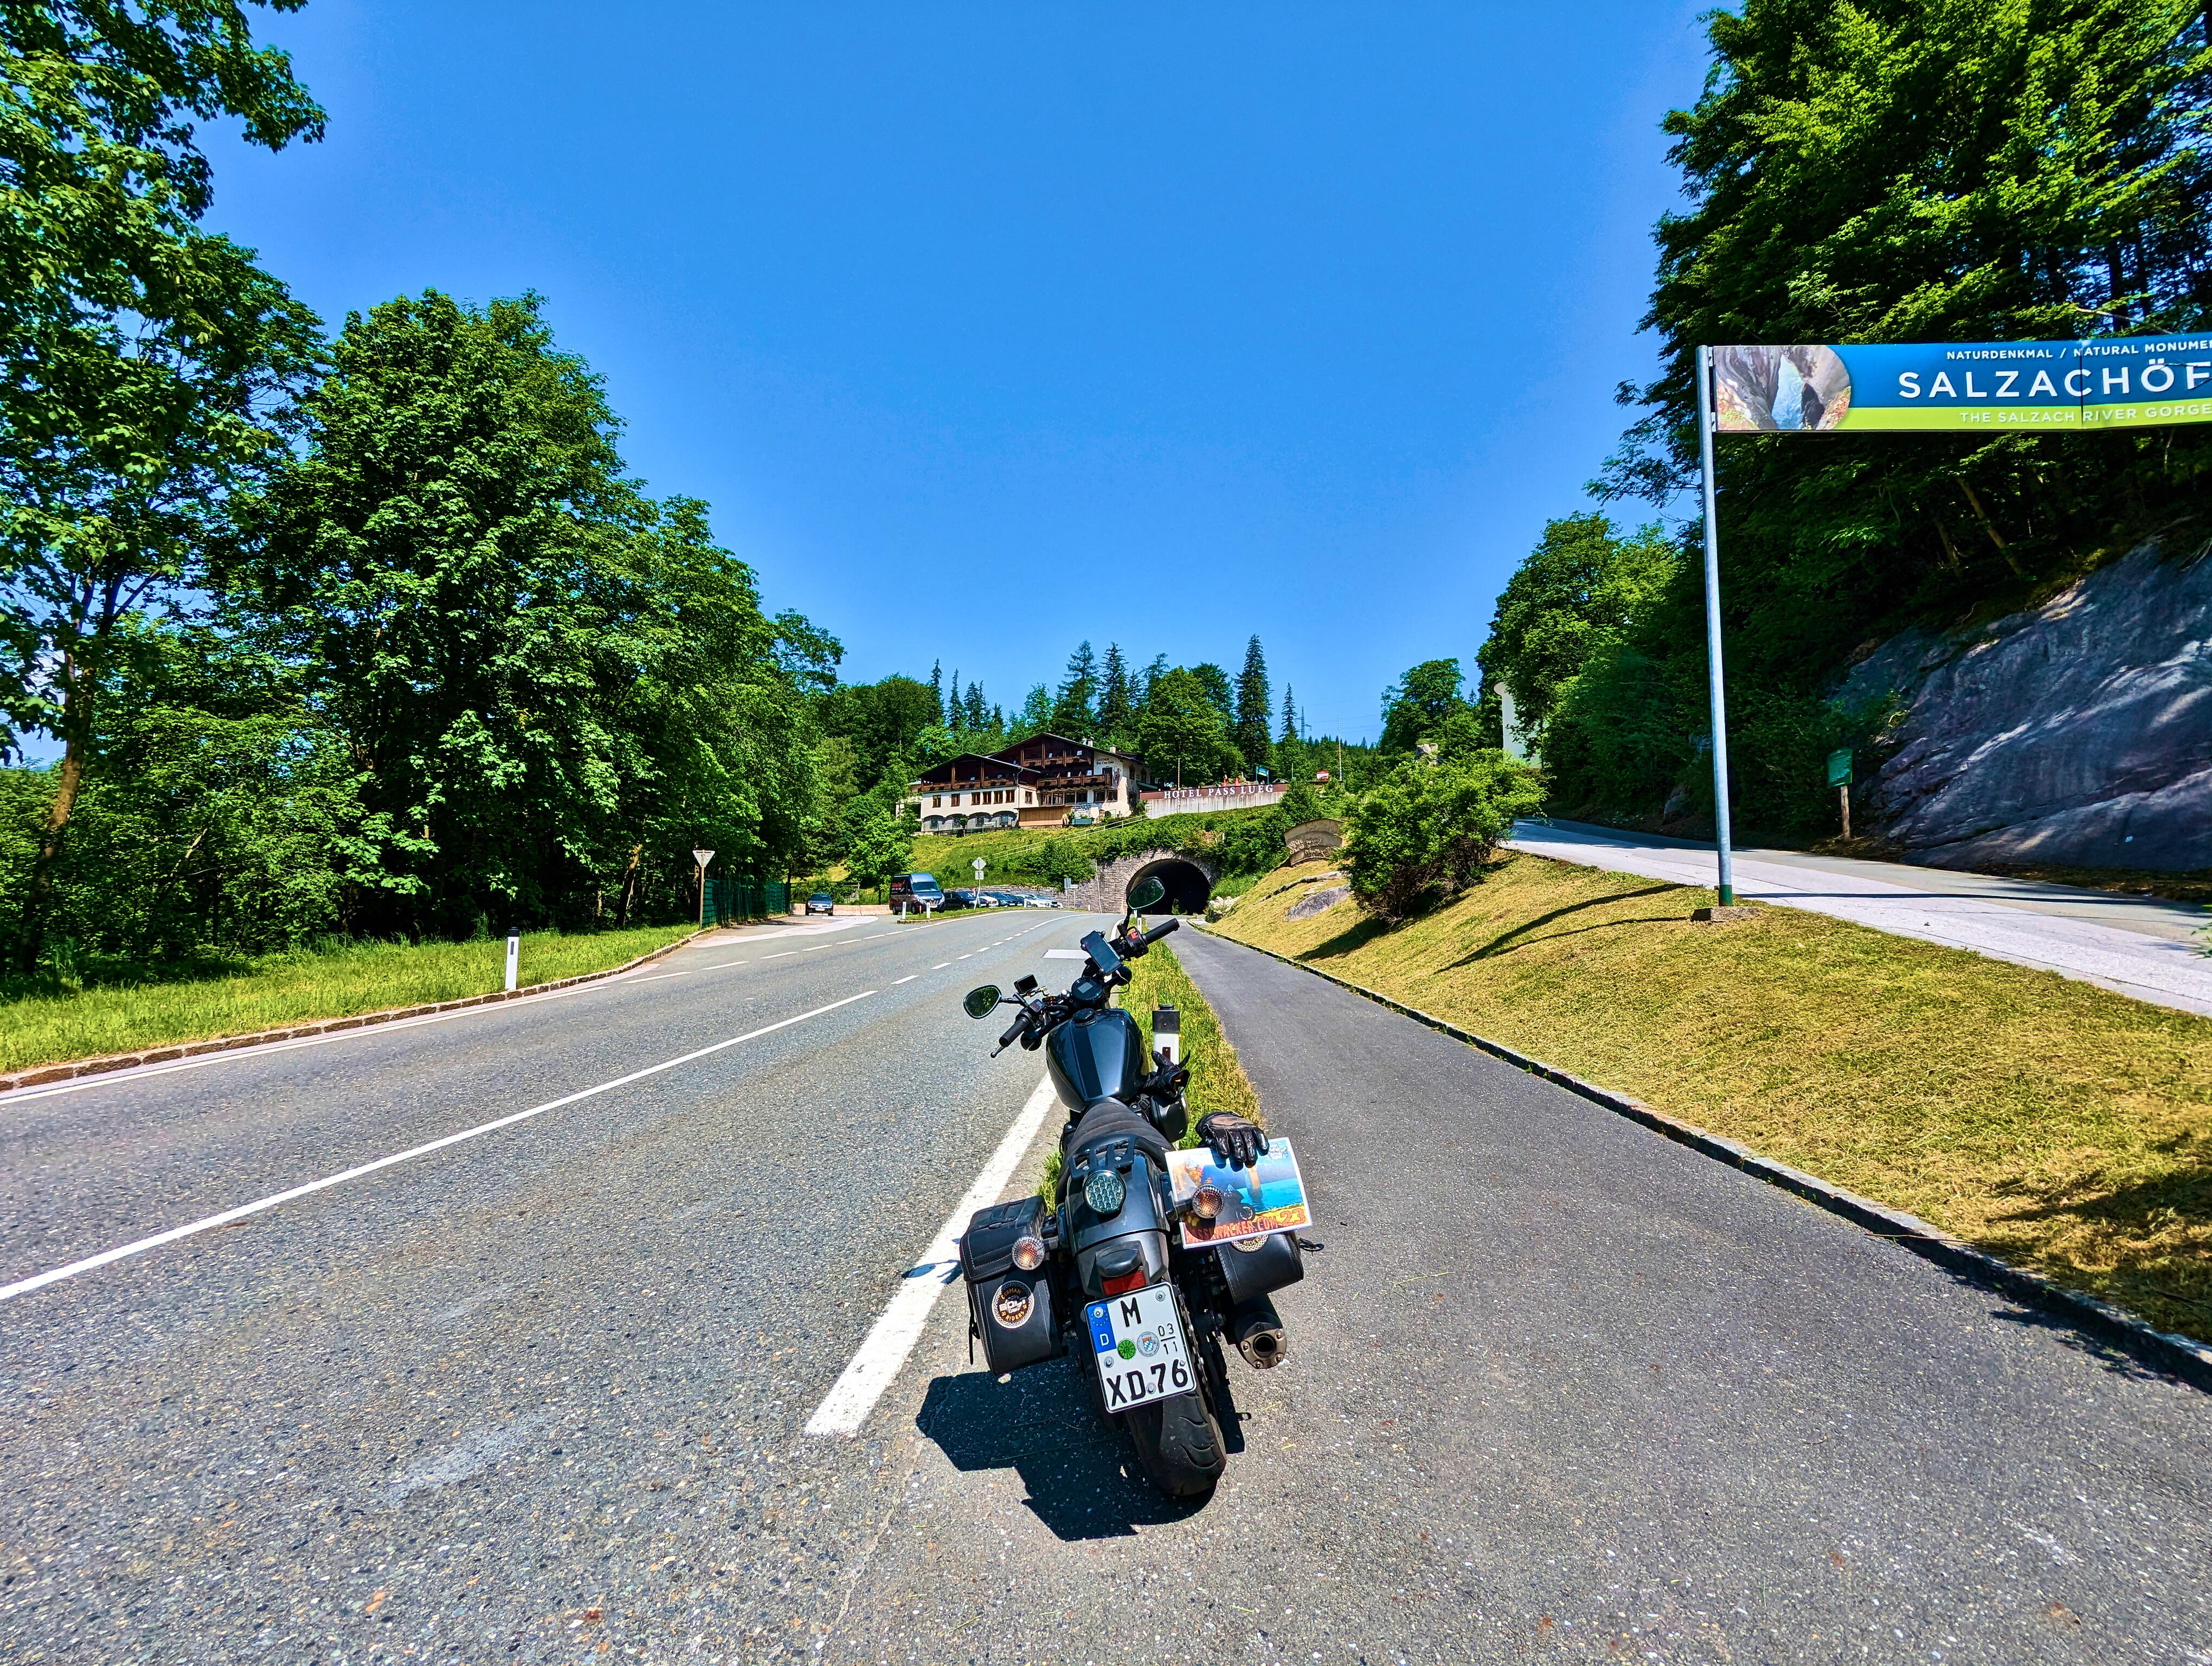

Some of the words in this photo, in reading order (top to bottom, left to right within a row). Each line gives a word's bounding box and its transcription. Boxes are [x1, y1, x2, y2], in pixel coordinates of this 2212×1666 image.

[1946, 349, 2053, 360] NATURDENKMAL
[2059, 348, 2067, 359] /
[2073, 344, 2139, 357] NATURAL
[1898, 357, 2211, 399] SALZACHÖF
[1960, 412, 1991, 422] THE
[1998, 411, 2075, 423] SALZACH
[2082, 408, 2137, 422] RIVER
[2145, 403, 2212, 418] GORGE
[1163, 789, 1202, 799] HOTEL
[1208, 786, 1236, 797] PASS
[1240, 784, 1274, 794] LUEG
[1279, 1208, 1306, 1228] 23
[1243, 1235, 1262, 1246] RIDERS
[1001, 1287, 1022, 1300] GERMAN
[1005, 1310, 1025, 1321] RIDERS
[1120, 1297, 1142, 1328] M
[1158, 1323, 1174, 1337] 03
[1099, 1333, 1110, 1347] D
[1163, 1341, 1178, 1355] 11
